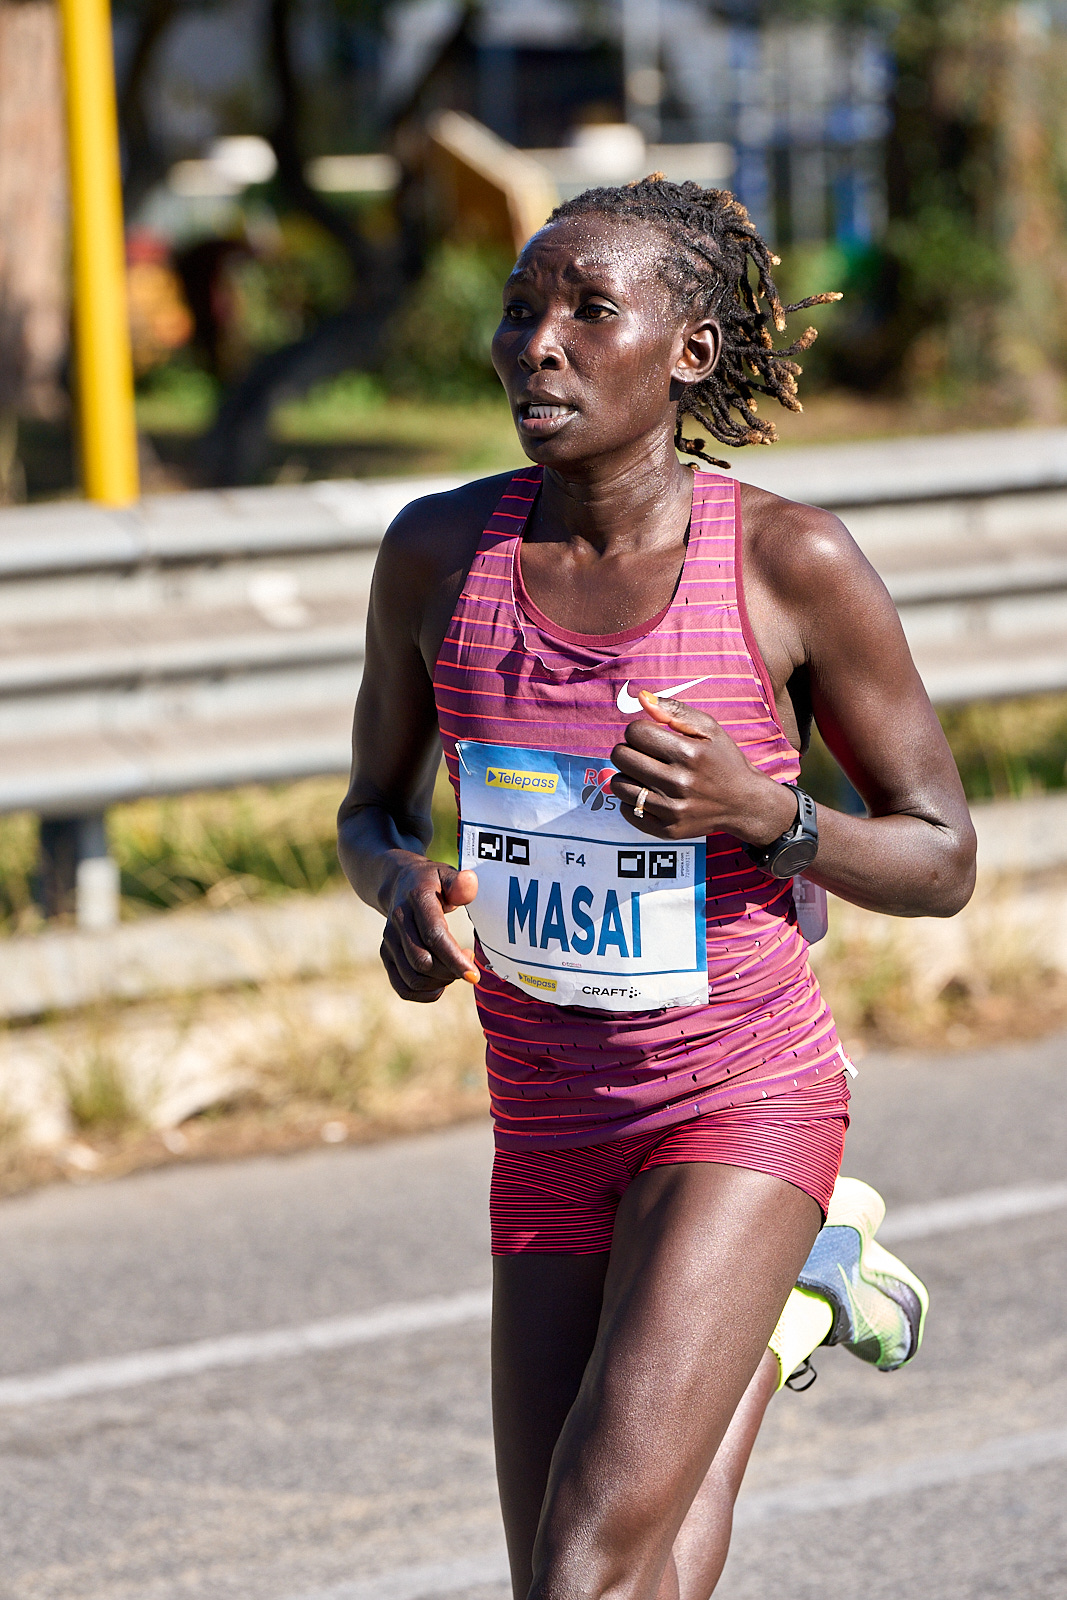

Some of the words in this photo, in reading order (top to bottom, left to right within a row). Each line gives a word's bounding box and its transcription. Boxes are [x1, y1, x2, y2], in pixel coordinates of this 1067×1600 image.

[498, 772, 555, 789] Telepass
[565, 851, 587, 868] F4
[507, 876, 642, 958] MASAI
[523, 975, 556, 989] Telepass
[582, 986, 628, 997] CRAFT
